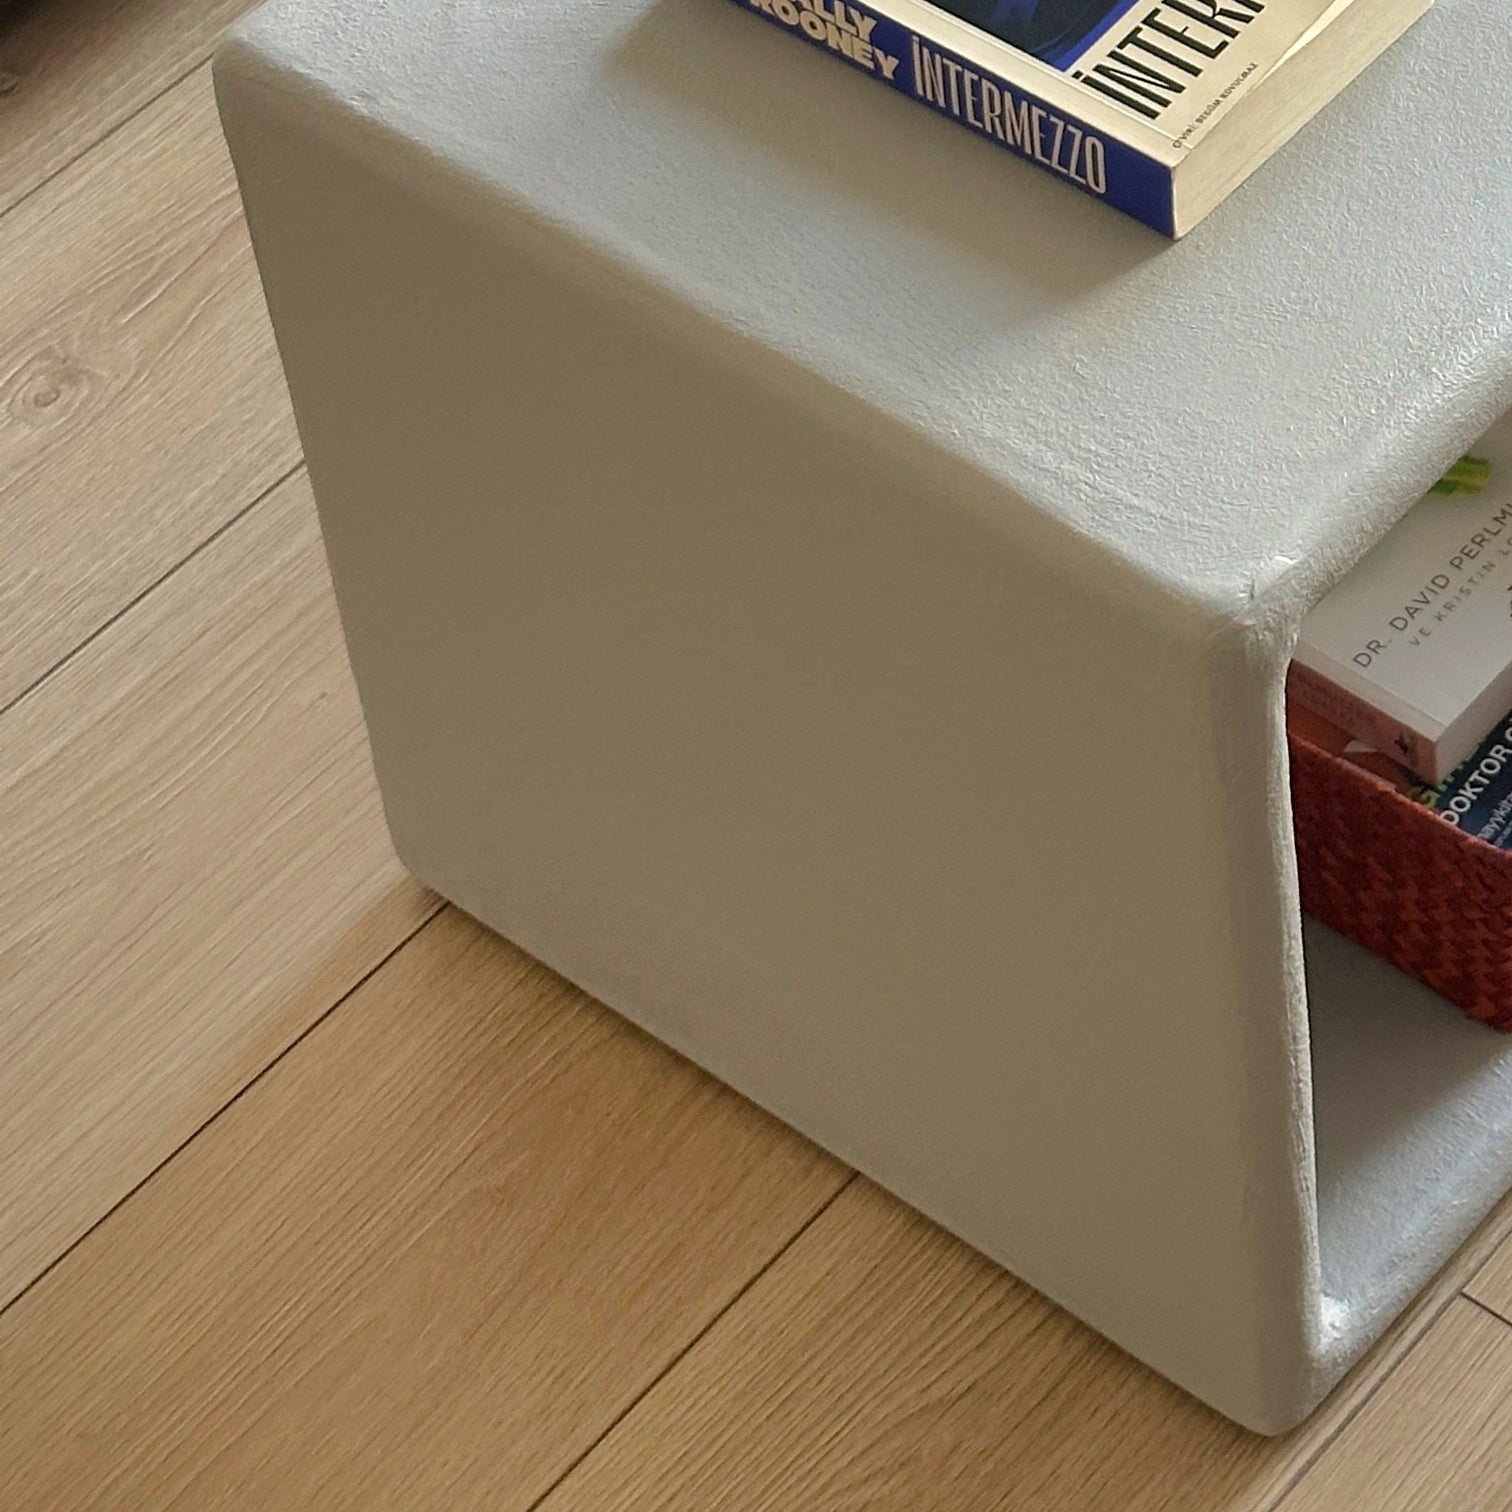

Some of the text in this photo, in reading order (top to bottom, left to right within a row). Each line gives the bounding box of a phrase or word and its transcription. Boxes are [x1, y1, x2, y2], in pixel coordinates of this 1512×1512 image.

[912, 35, 1106, 194] İNTERMEZZO
[1353, 639, 1392, 668] DR.
[1389, 574, 1450, 631] DAVID
[1409, 626, 1432, 648] VE
[1434, 561, 1496, 622] KRISTIN
